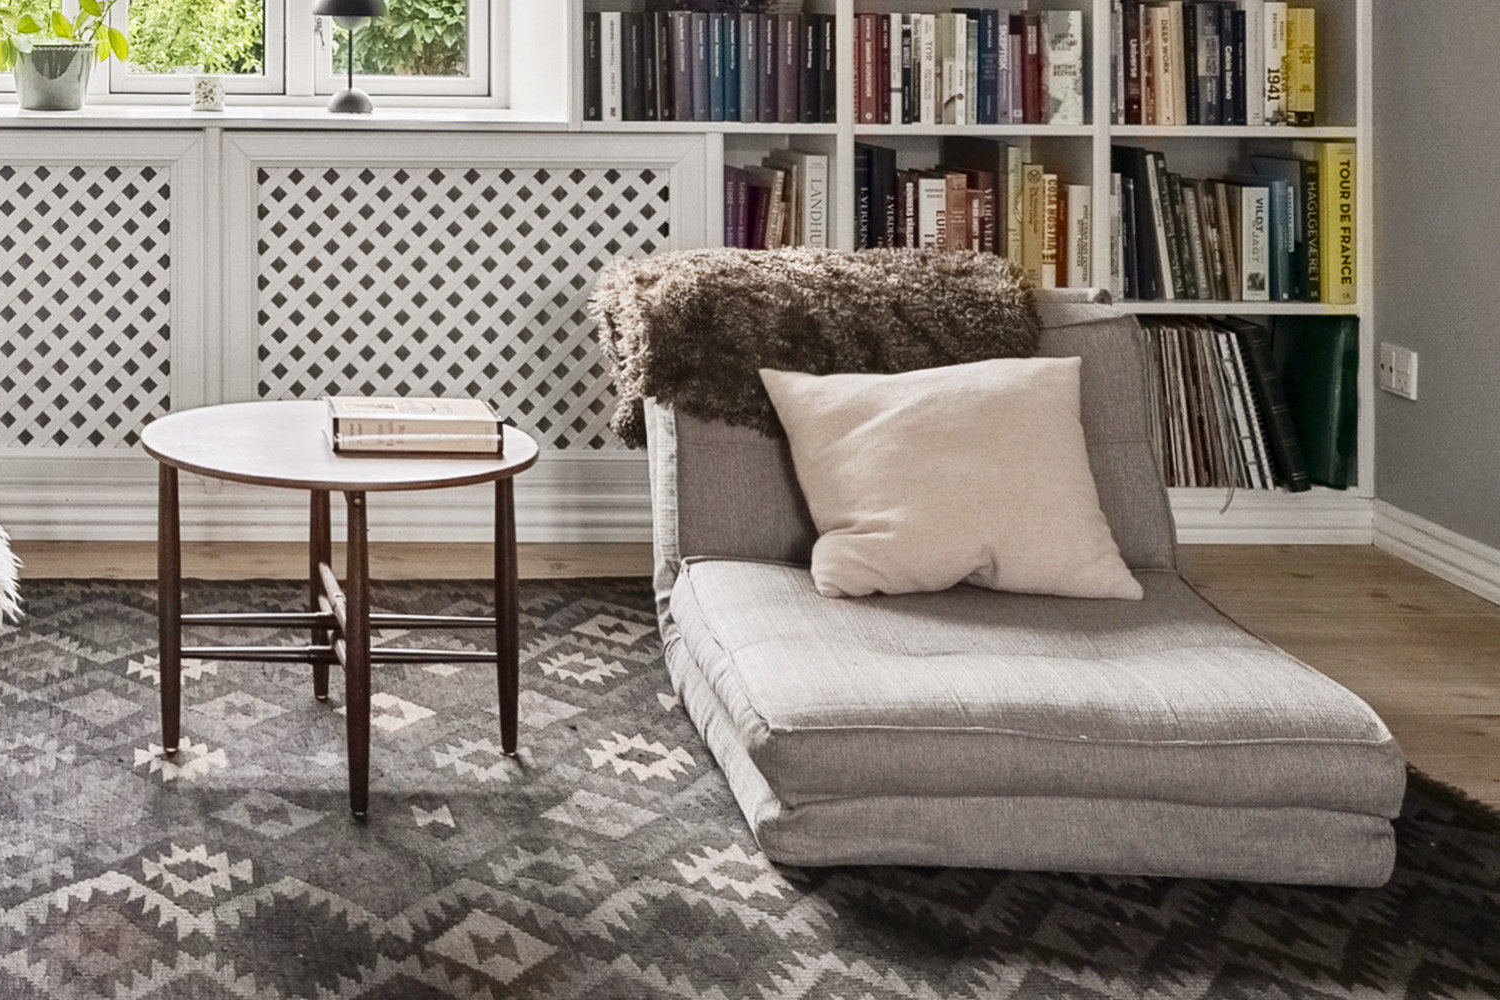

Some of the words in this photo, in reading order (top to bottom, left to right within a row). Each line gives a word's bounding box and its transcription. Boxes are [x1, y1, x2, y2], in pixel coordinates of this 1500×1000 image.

[999, 24, 1009, 71] SKEPTISK
[1161, 19, 1169, 44] DEEP
[1129, 38, 1139, 79] Universe
[1162, 45, 1171, 75] WORK
[1225, 45, 1233, 71] Calcio
[1225, 71, 1233, 100] Italiano
[1267, 67, 1281, 102] 1941
[1047, 179, 1057, 209] COSA
[1339, 159, 1351, 200] TOUR
[810, 179, 823, 246] LANDHU
[1047, 210, 1057, 251] NOSTRA
[1255, 197, 1264, 234] VILDT
[1340, 203, 1351, 223] DE
[1251, 230, 1261, 264] JAGT
[1306, 181, 1319, 283] HAGLGEVÆRET
[1340, 226, 1352, 286] FRANCE
